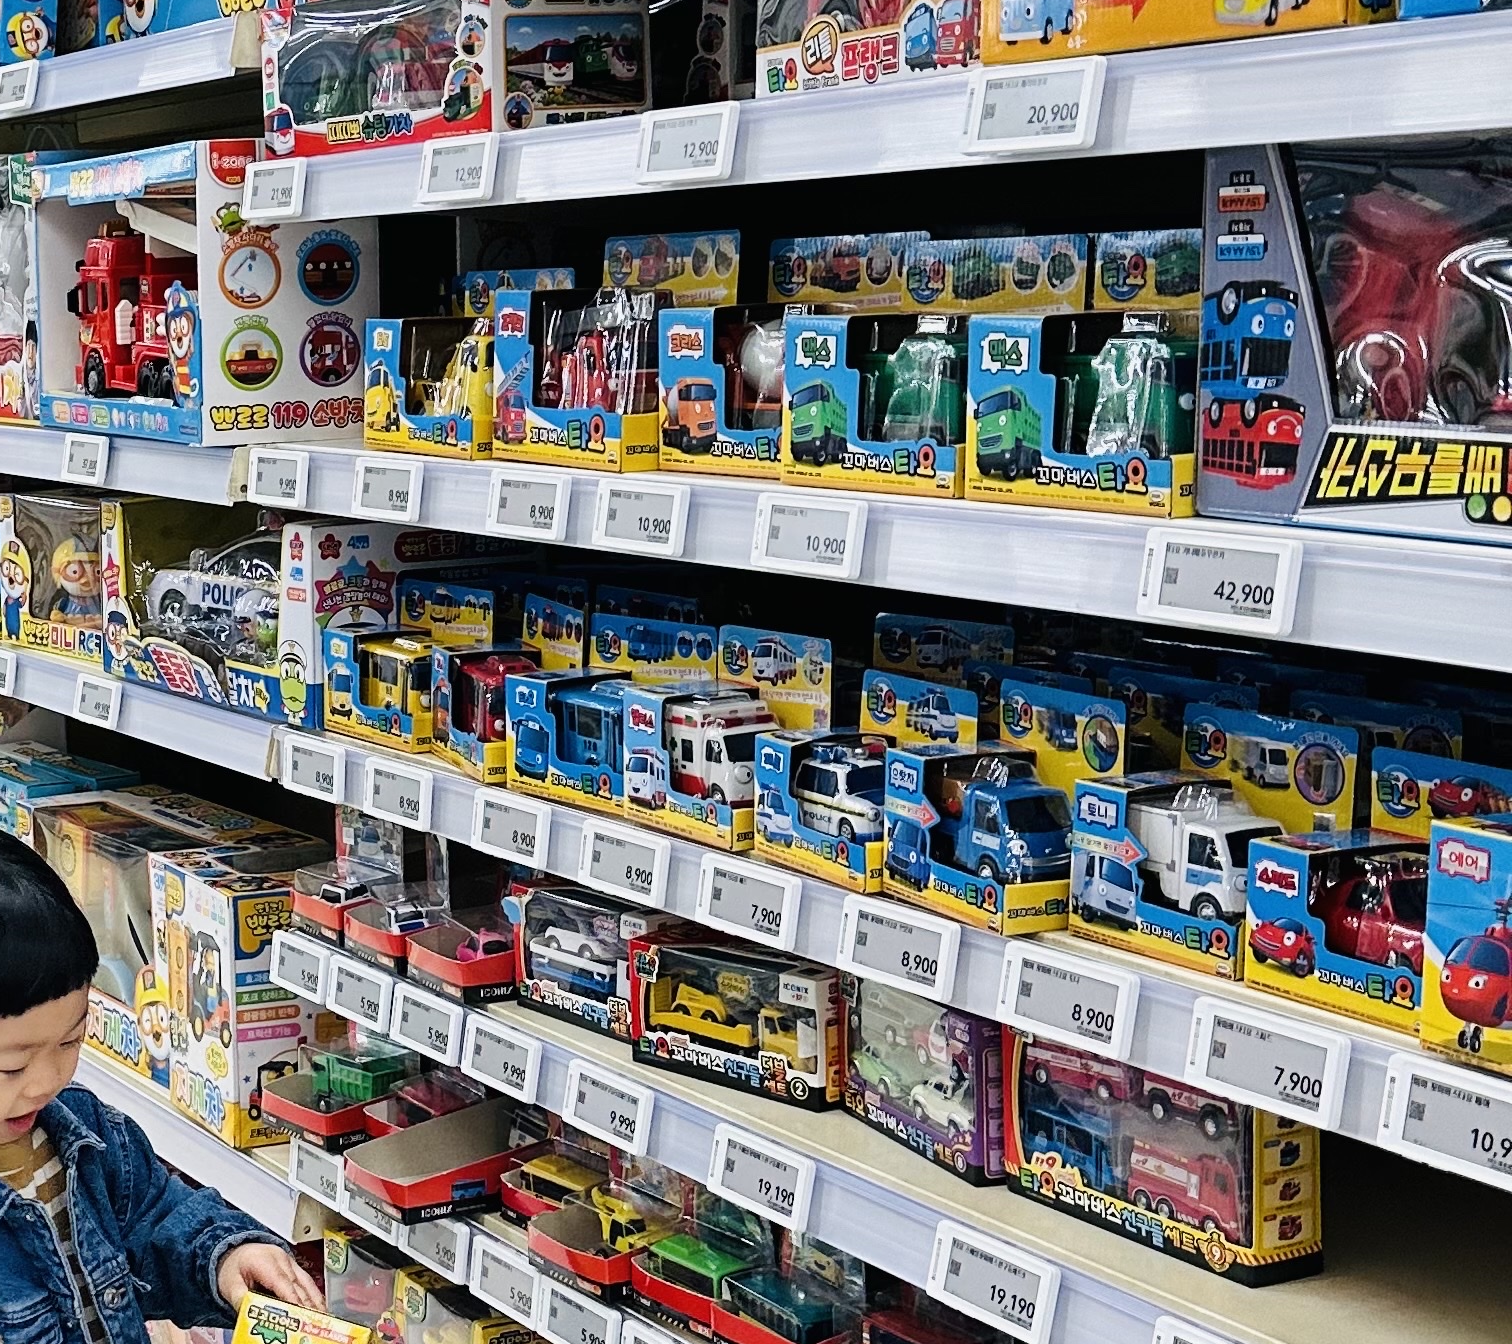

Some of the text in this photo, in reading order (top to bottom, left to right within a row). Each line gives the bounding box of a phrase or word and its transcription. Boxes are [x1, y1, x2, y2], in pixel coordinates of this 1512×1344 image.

[842, 34, 900, 82] 프랭크
[1027, 103, 1079, 126] 20,900
[683, 140, 719, 162] 12,900
[454, 165, 483, 184] 12,900
[270, 187, 293, 202] 21,900
[801, 336, 832, 363] 맥스
[989, 337, 1023, 368] 맥스
[529, 415, 606, 452] 꼬마버스 타요
[842, 444, 936, 477] 꼬마버스 타요
[1036, 455, 1149, 494] 꼬마버스 타요
[388, 490, 409, 506] 8,900
[529, 504, 555, 523] 8,900
[638, 517, 671, 536] 10,900
[805, 535, 846, 557] 10,900
[1213, 579, 1275, 608] 42,900
[399, 796, 420, 816] 8,900
[803, 809, 833, 824] POLICE
[1083, 801, 1113, 825] 토니
[512, 829, 537, 850] 8,900
[1446, 848, 1483, 873] 에어
[625, 865, 653, 887] 8,900
[1256, 869, 1299, 894] 스피드
[933, 875, 1000, 914] 꼬마버스 타요
[751, 904, 782, 930] 7,900
[1140, 920, 1230, 959] 꼬마버스 타요
[900, 950, 939, 978] 8,900
[1318, 966, 1416, 1011] 꼬마버스 타요
[1071, 1003, 1116, 1034] 8,900
[426, 1026, 450, 1049] 5,900
[502, 1061, 526, 1084] 9,990
[639, 1036, 670, 1060] 타요
[670, 1044, 726, 1072] 꼬마버스
[723, 1056, 762, 1089] 친구들
[762, 1078, 789, 1097] 세트
[794, 1082, 806, 1096] 2
[1273, 1065, 1324, 1100] 7,900
[610, 1110, 636, 1136] 9,990
[844, 1091, 866, 1117] 타요
[867, 1102, 909, 1140] 꼬마버스
[906, 1123, 937, 1162] 친구들
[758, 1178, 795, 1208] 19,190
[1019, 1167, 1221, 1262] 타요 꼬마버스 친구들 세트 9
[990, 1285, 1036, 1320] 19,190
